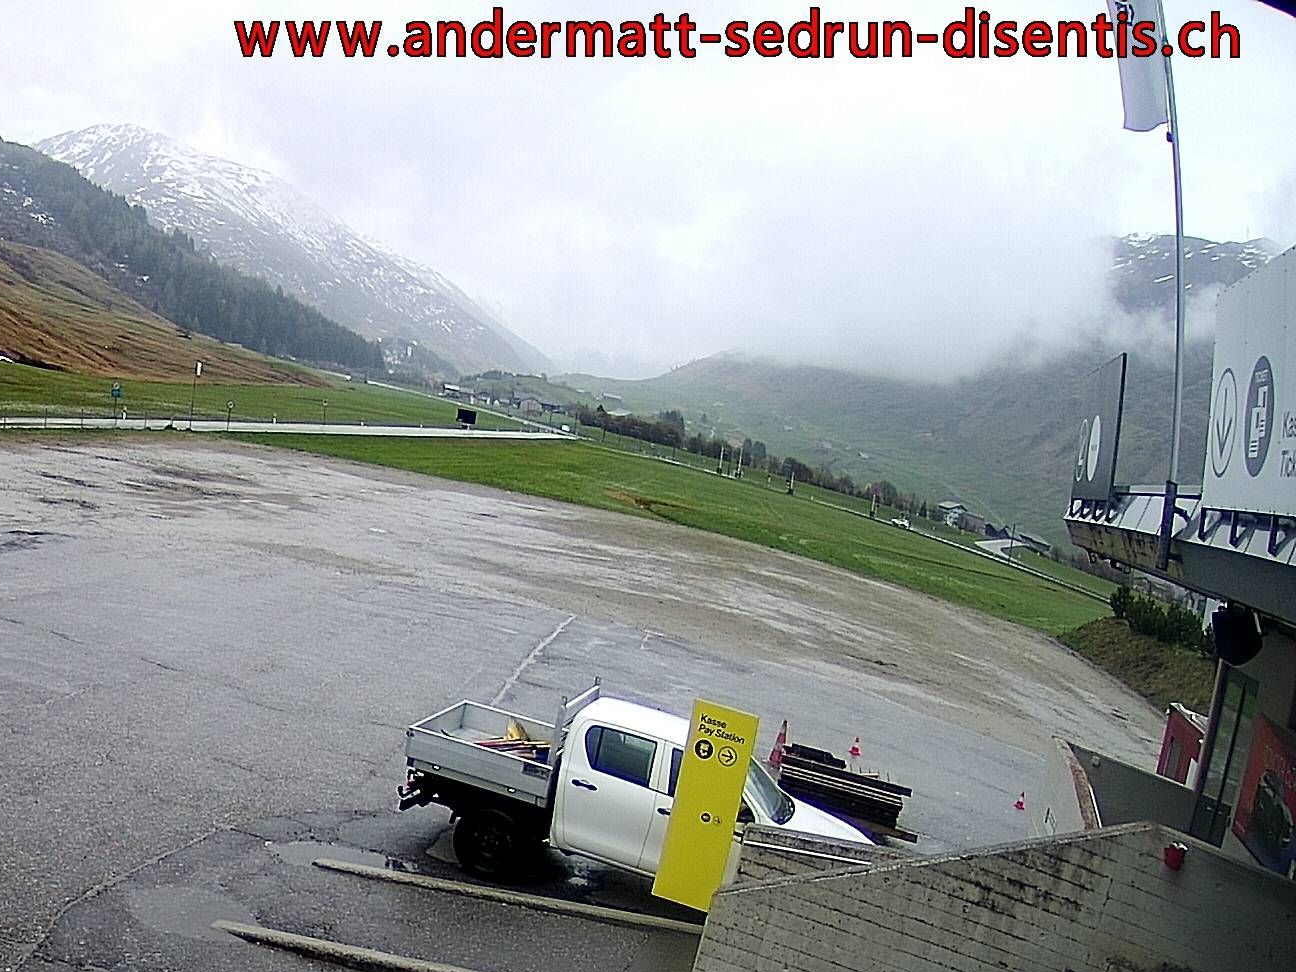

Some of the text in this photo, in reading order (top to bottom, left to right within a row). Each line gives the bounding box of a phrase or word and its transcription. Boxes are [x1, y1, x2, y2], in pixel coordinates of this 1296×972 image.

[701, 713, 727, 729] Kasse
[698, 723, 745, 745] Pay Station
